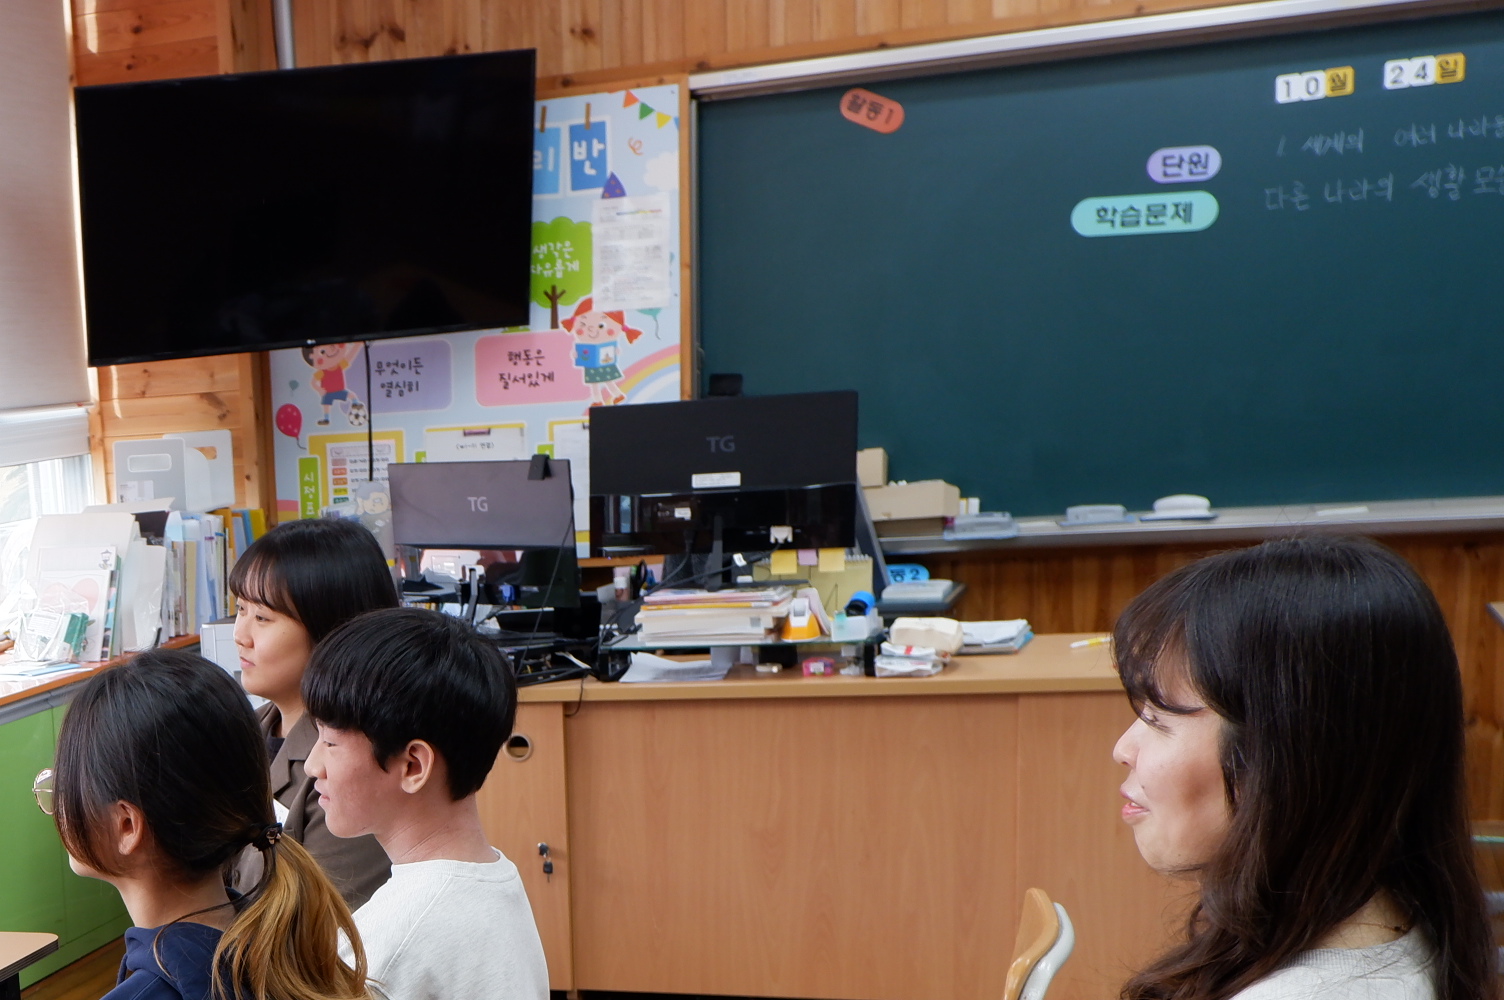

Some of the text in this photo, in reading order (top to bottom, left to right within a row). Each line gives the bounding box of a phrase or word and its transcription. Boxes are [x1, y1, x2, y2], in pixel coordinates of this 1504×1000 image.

[1282, 57, 1458, 97] 10월 24일
[1161, 151, 1210, 178] 단원
[1264, 180, 1310, 211] 다른
[1324, 171, 1394, 203] 나라의
[1410, 163, 1465, 200] 생활
[1095, 201, 1194, 229] 학습문제
[533, 241, 574, 260] 생각은
[375, 356, 425, 376] 무엇이든
[506, 349, 546, 367] 행동은
[380, 378, 420, 398] 열심히
[497, 369, 556, 390] 질서있게
[705, 436, 736, 452] TG
[303, 472, 317, 516] 시정표
[467, 495, 489, 512] TG
[890, 567, 921, 583] 동 2
